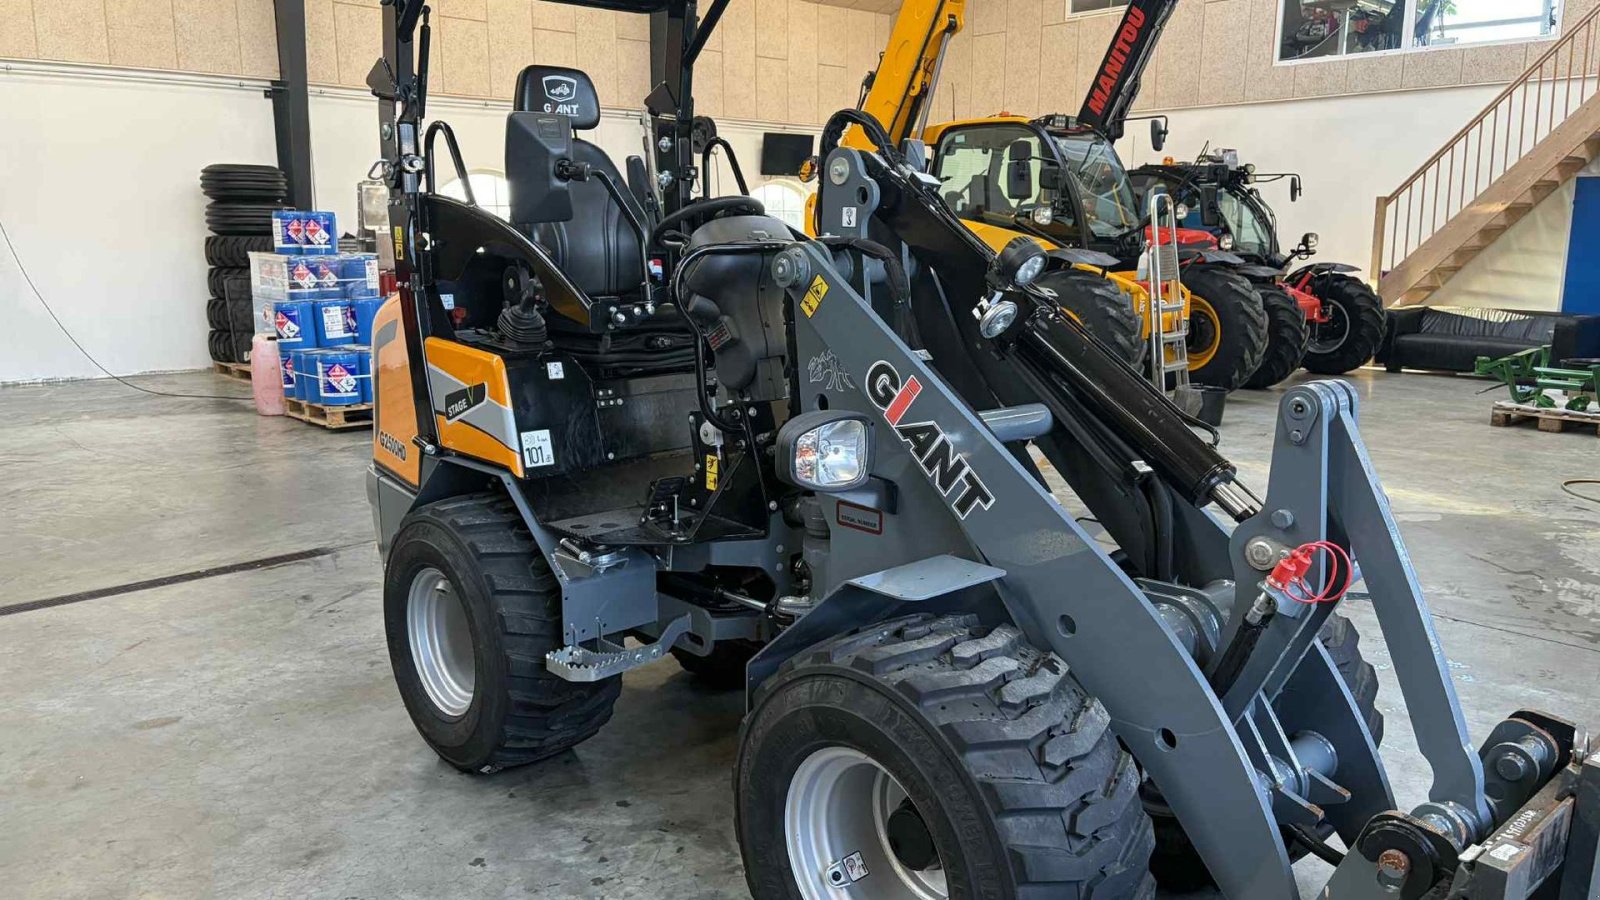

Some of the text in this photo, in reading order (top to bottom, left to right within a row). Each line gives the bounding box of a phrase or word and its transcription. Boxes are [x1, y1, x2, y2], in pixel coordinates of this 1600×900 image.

[1088, 5, 1146, 117] MANITOU
[447, 398, 468, 417] STAGE
[379, 430, 407, 462] G2500HD
[525, 445, 545, 465] 101
[865, 359, 996, 521] GIANT
